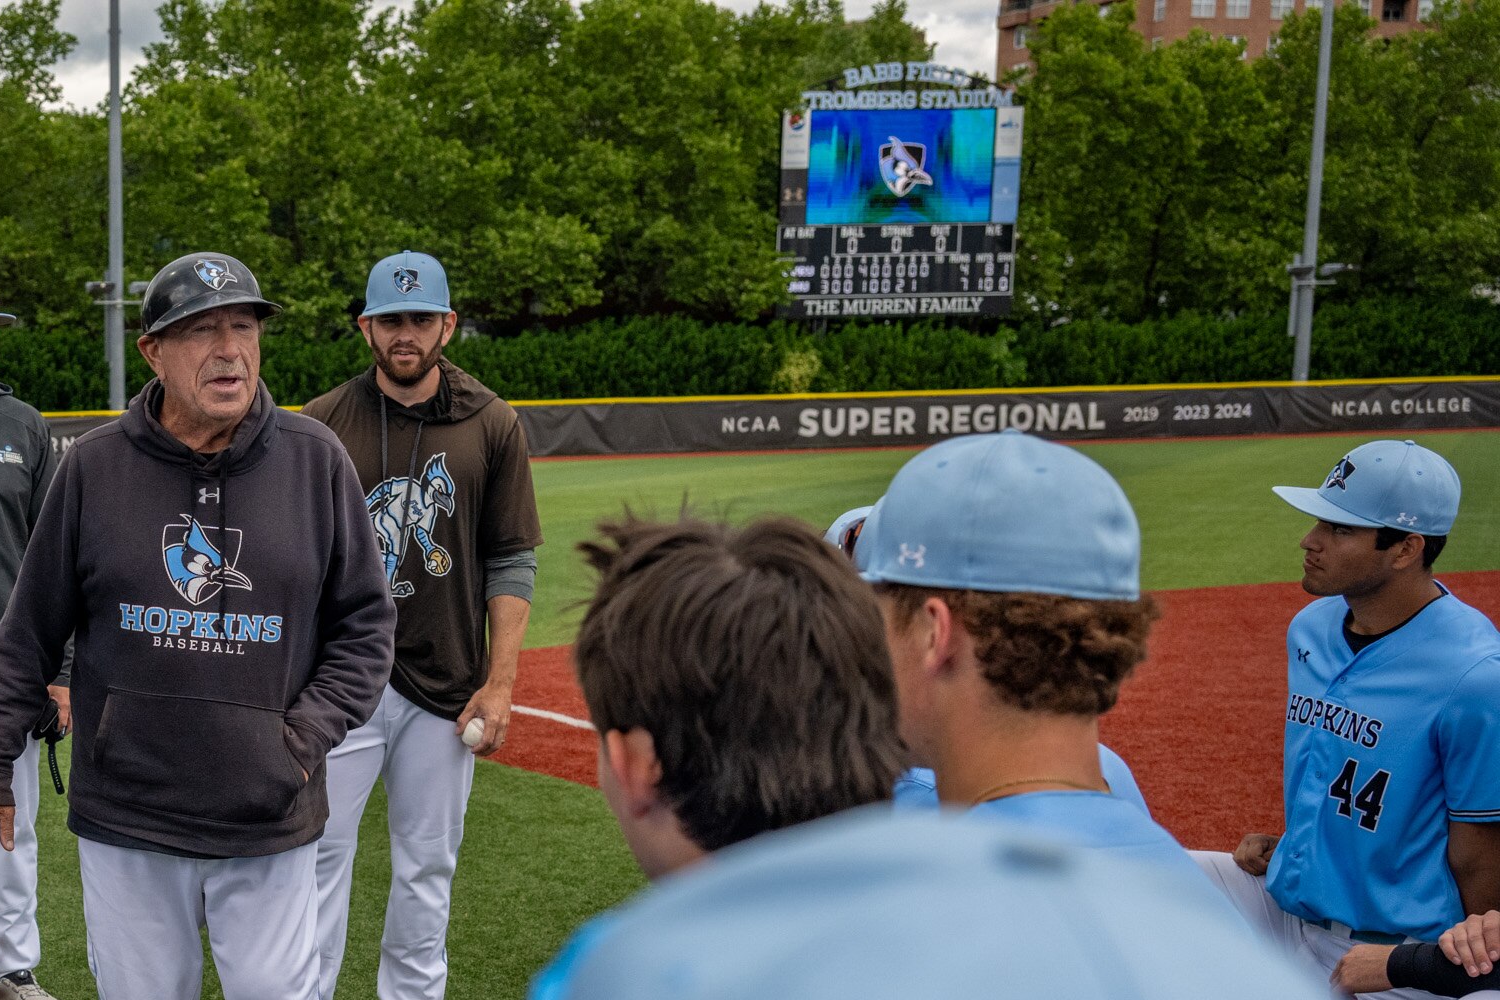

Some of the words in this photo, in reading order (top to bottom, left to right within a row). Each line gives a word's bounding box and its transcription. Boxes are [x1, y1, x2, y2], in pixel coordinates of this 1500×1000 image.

[843, 62, 904, 88] BABB
[919, 88, 1014, 109] STADIUM
[847, 236, 858, 254] 0
[891, 236, 902, 254] 0
[935, 235, 946, 253] 0
[803, 299, 840, 316] THE
[841, 297, 917, 315] MURREN
[919, 296, 984, 314] FAMILY
[1123, 407, 1159, 422] 2019
[1173, 405, 1210, 421] 2023
[1213, 403, 1252, 420] 2024
[1331, 401, 1383, 417] NCAA
[1390, 397, 1472, 415] COLLEGE
[721, 416, 781, 433] NCAA
[798, 406, 915, 437] SUPER
[927, 402, 1107, 435] REGIONAL
[119, 602, 283, 643] HOPKINS
[153, 635, 245, 656] BASEBALL
[1287, 694, 1384, 749] HOPKINS
[1328, 757, 1391, 834] 44
